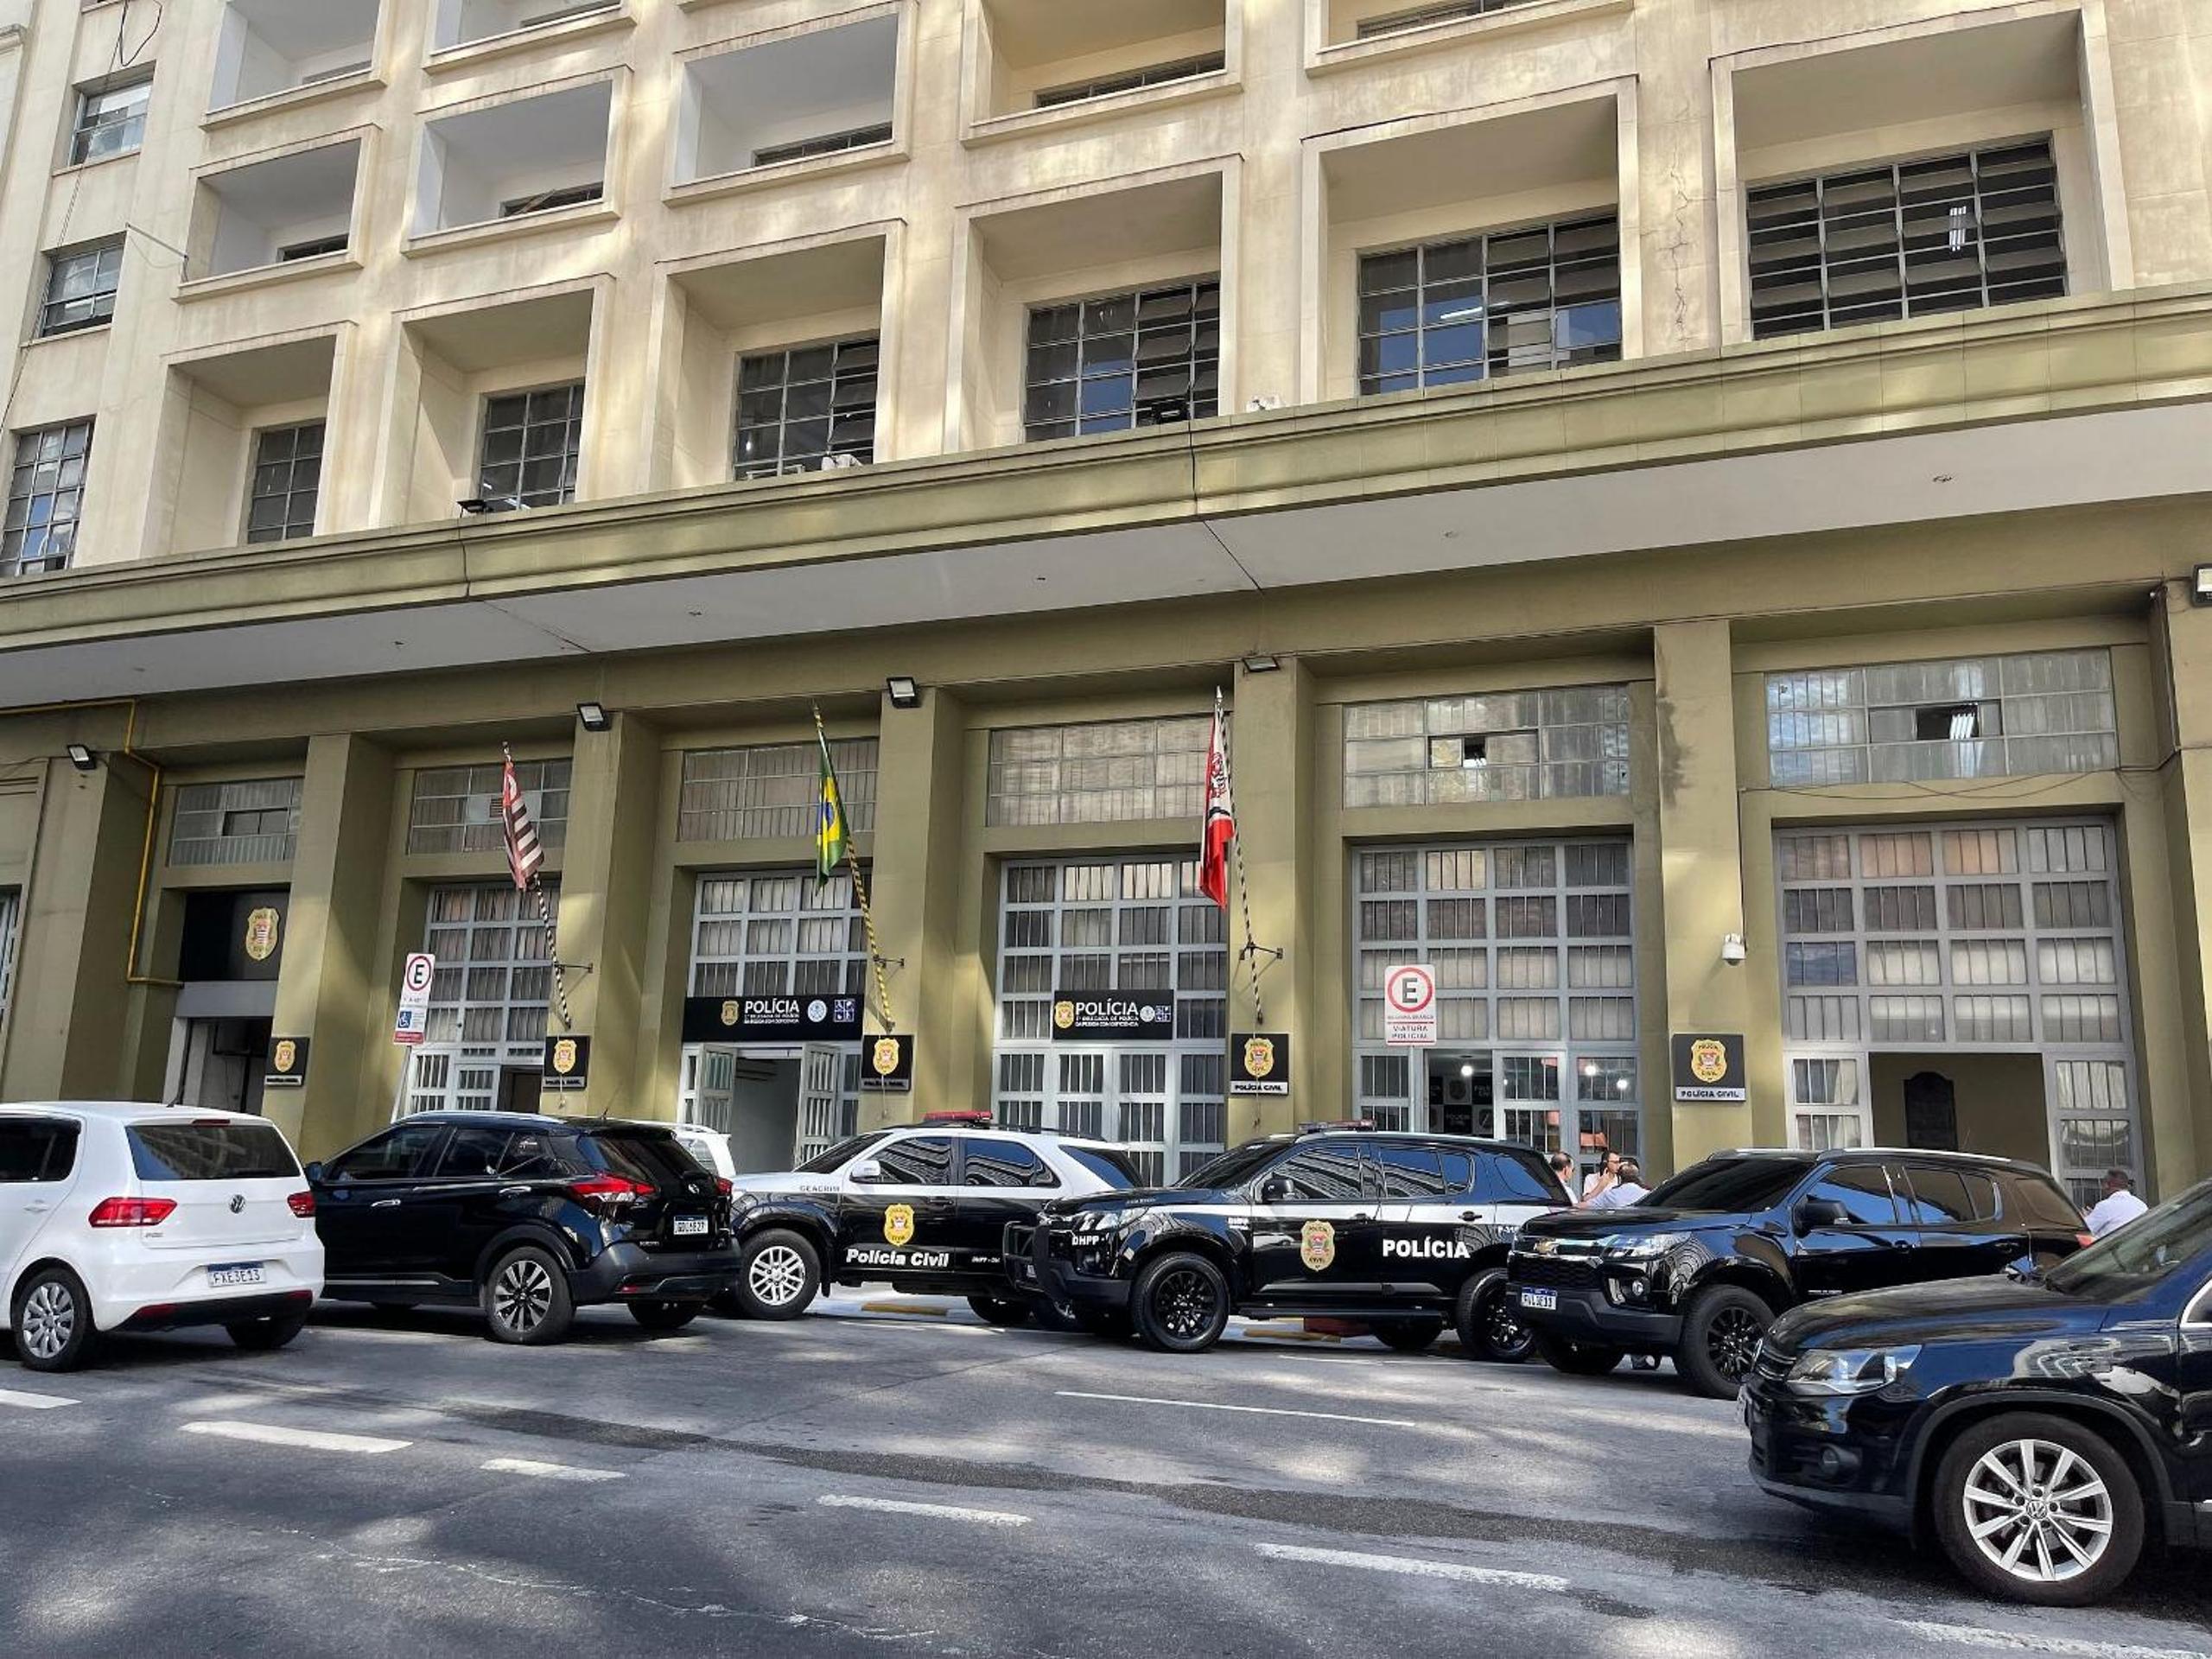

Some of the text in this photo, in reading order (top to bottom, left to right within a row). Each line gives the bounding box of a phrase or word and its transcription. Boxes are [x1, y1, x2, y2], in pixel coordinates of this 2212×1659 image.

[414, 964, 424, 984] E
[1402, 978, 1418, 1003] E
[745, 998, 799, 1014] POLÍCIA
[1076, 998, 1139, 1015] POLÍCIA
[1382, 1235, 1471, 1259] POLÍCIA
[846, 1248, 950, 1267] Polícia Civil
